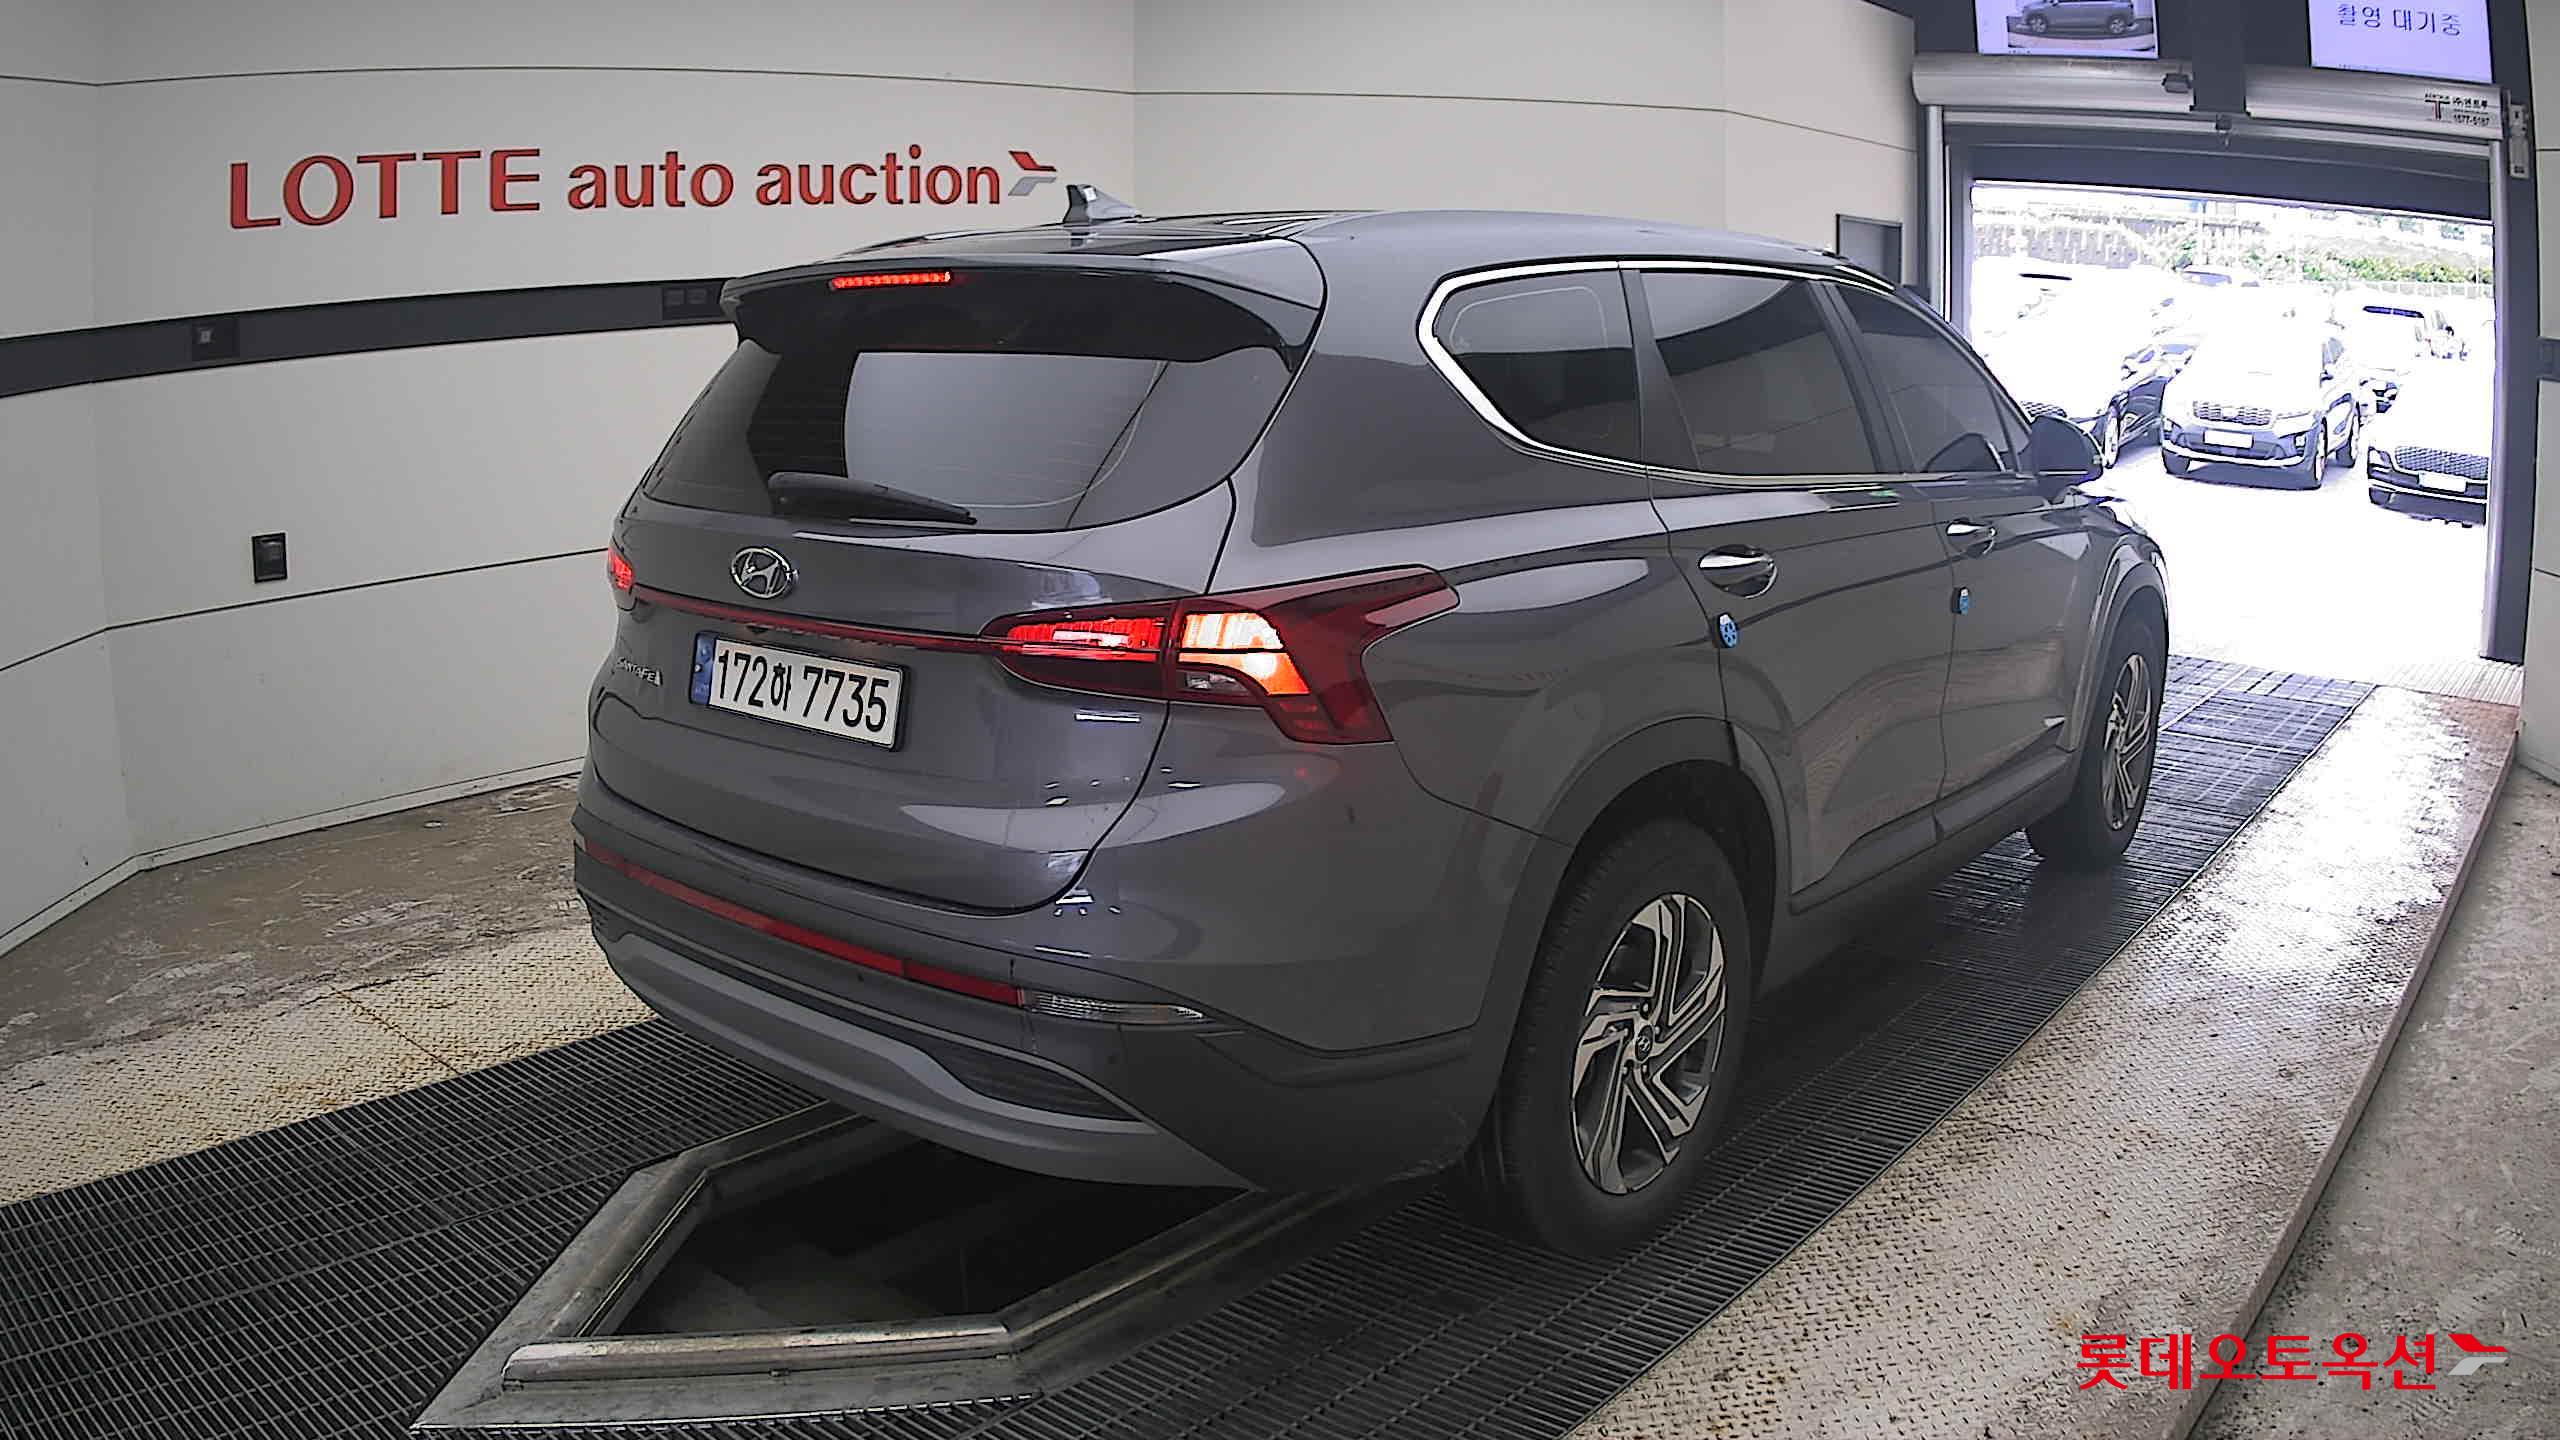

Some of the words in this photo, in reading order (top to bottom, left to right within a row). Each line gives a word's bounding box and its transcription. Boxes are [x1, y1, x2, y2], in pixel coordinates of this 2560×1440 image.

[2338, 3, 2381, 28] 촬영
[2393, 9, 2460, 36] 대기중
[230, 148, 540, 229] LOTTE
[568, 151, 734, 210] auto
[756, 144, 1001, 205] auction
[718, 650, 792, 711] 172하
[802, 665, 890, 732] 7735
